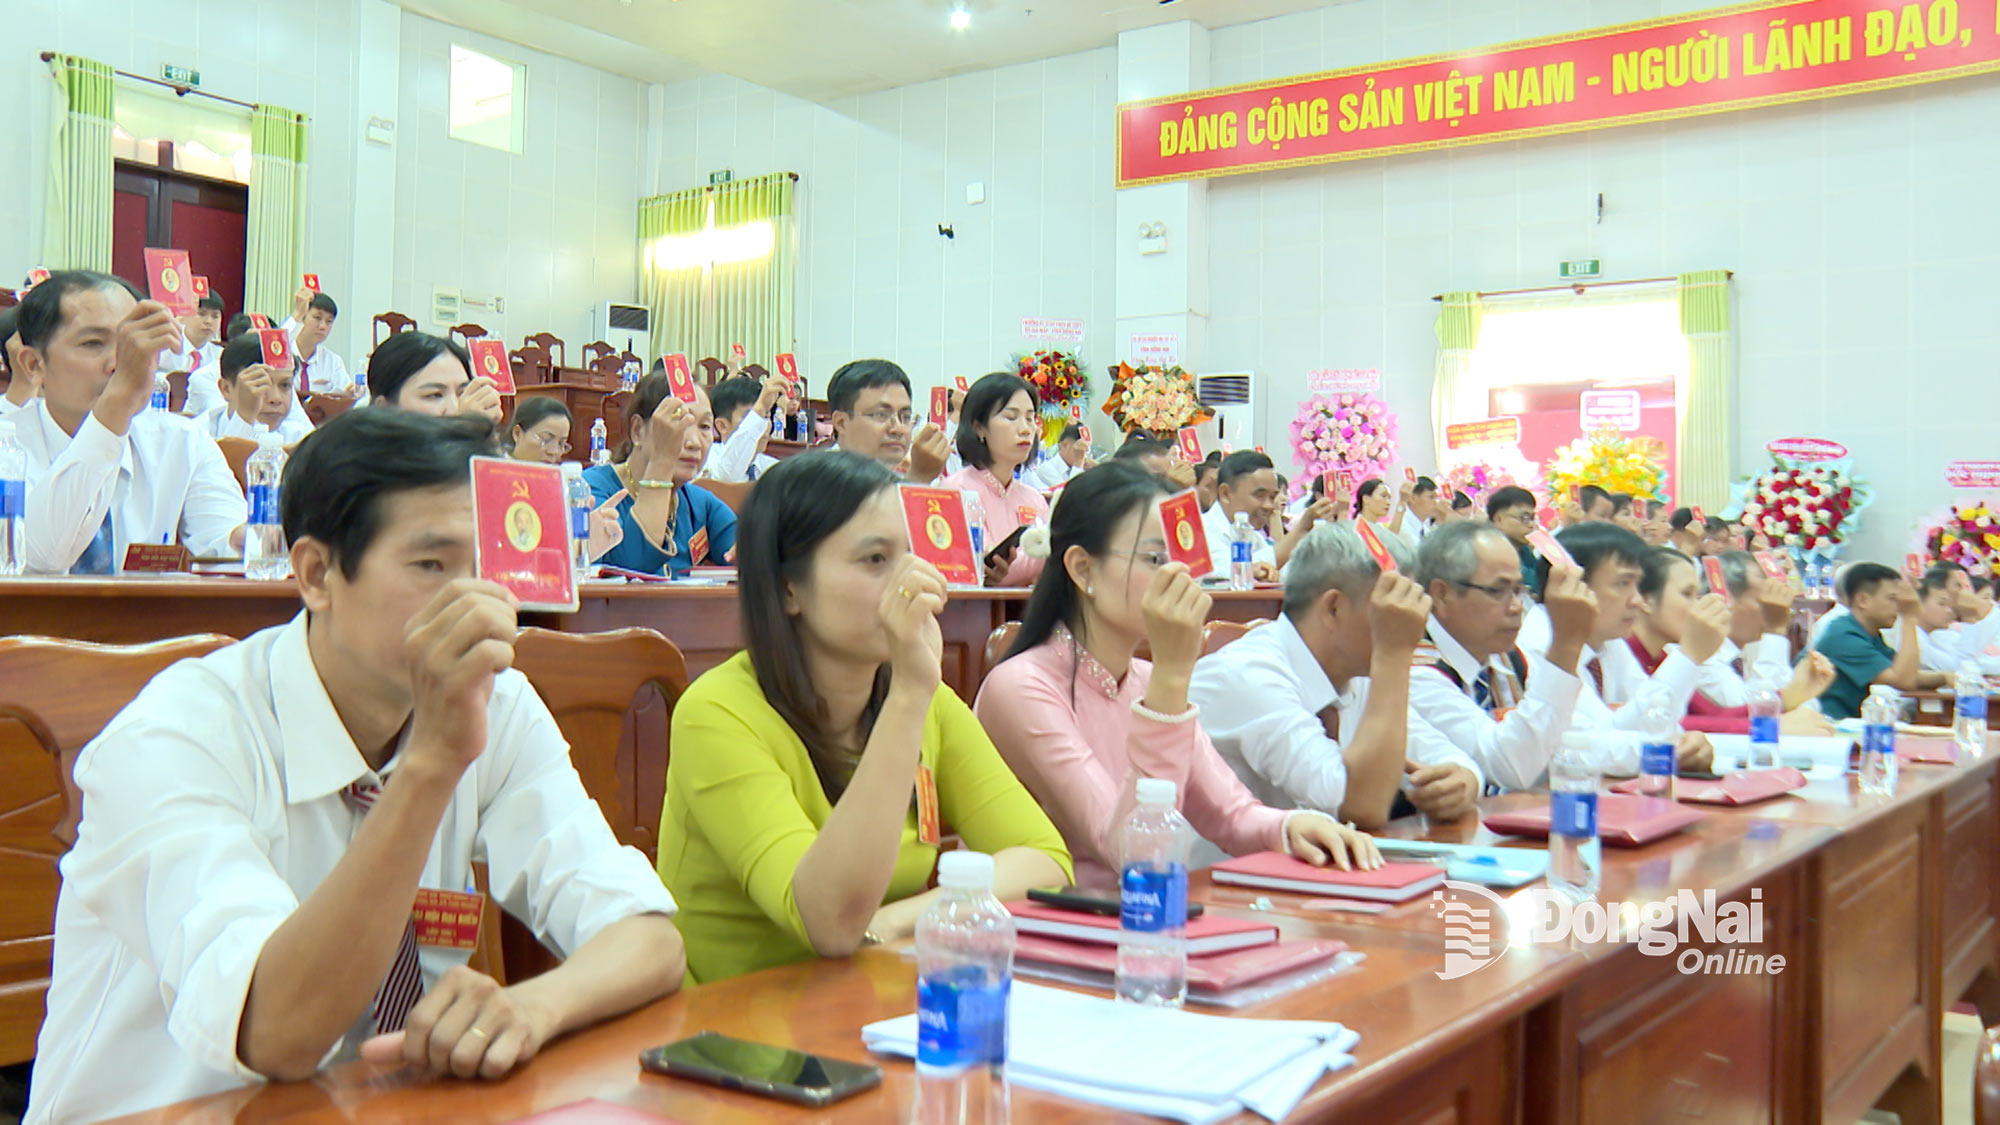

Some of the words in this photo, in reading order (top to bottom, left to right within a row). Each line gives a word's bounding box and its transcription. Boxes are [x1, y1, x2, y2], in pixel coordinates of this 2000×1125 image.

[1159, 105, 1238, 157] ĐẢNG
[1247, 97, 1329, 149] CỘNG
[1339, 79, 1404, 132] SẢN
[1413, 69, 1484, 127] VIỆT
[1494, 61, 1575, 111] NAM
[1612, 29, 1729, 95] NGƯỜI
[1743, 18, 1851, 76] LÃNH
[1864, 0, 1973, 61] ĐẠO,
